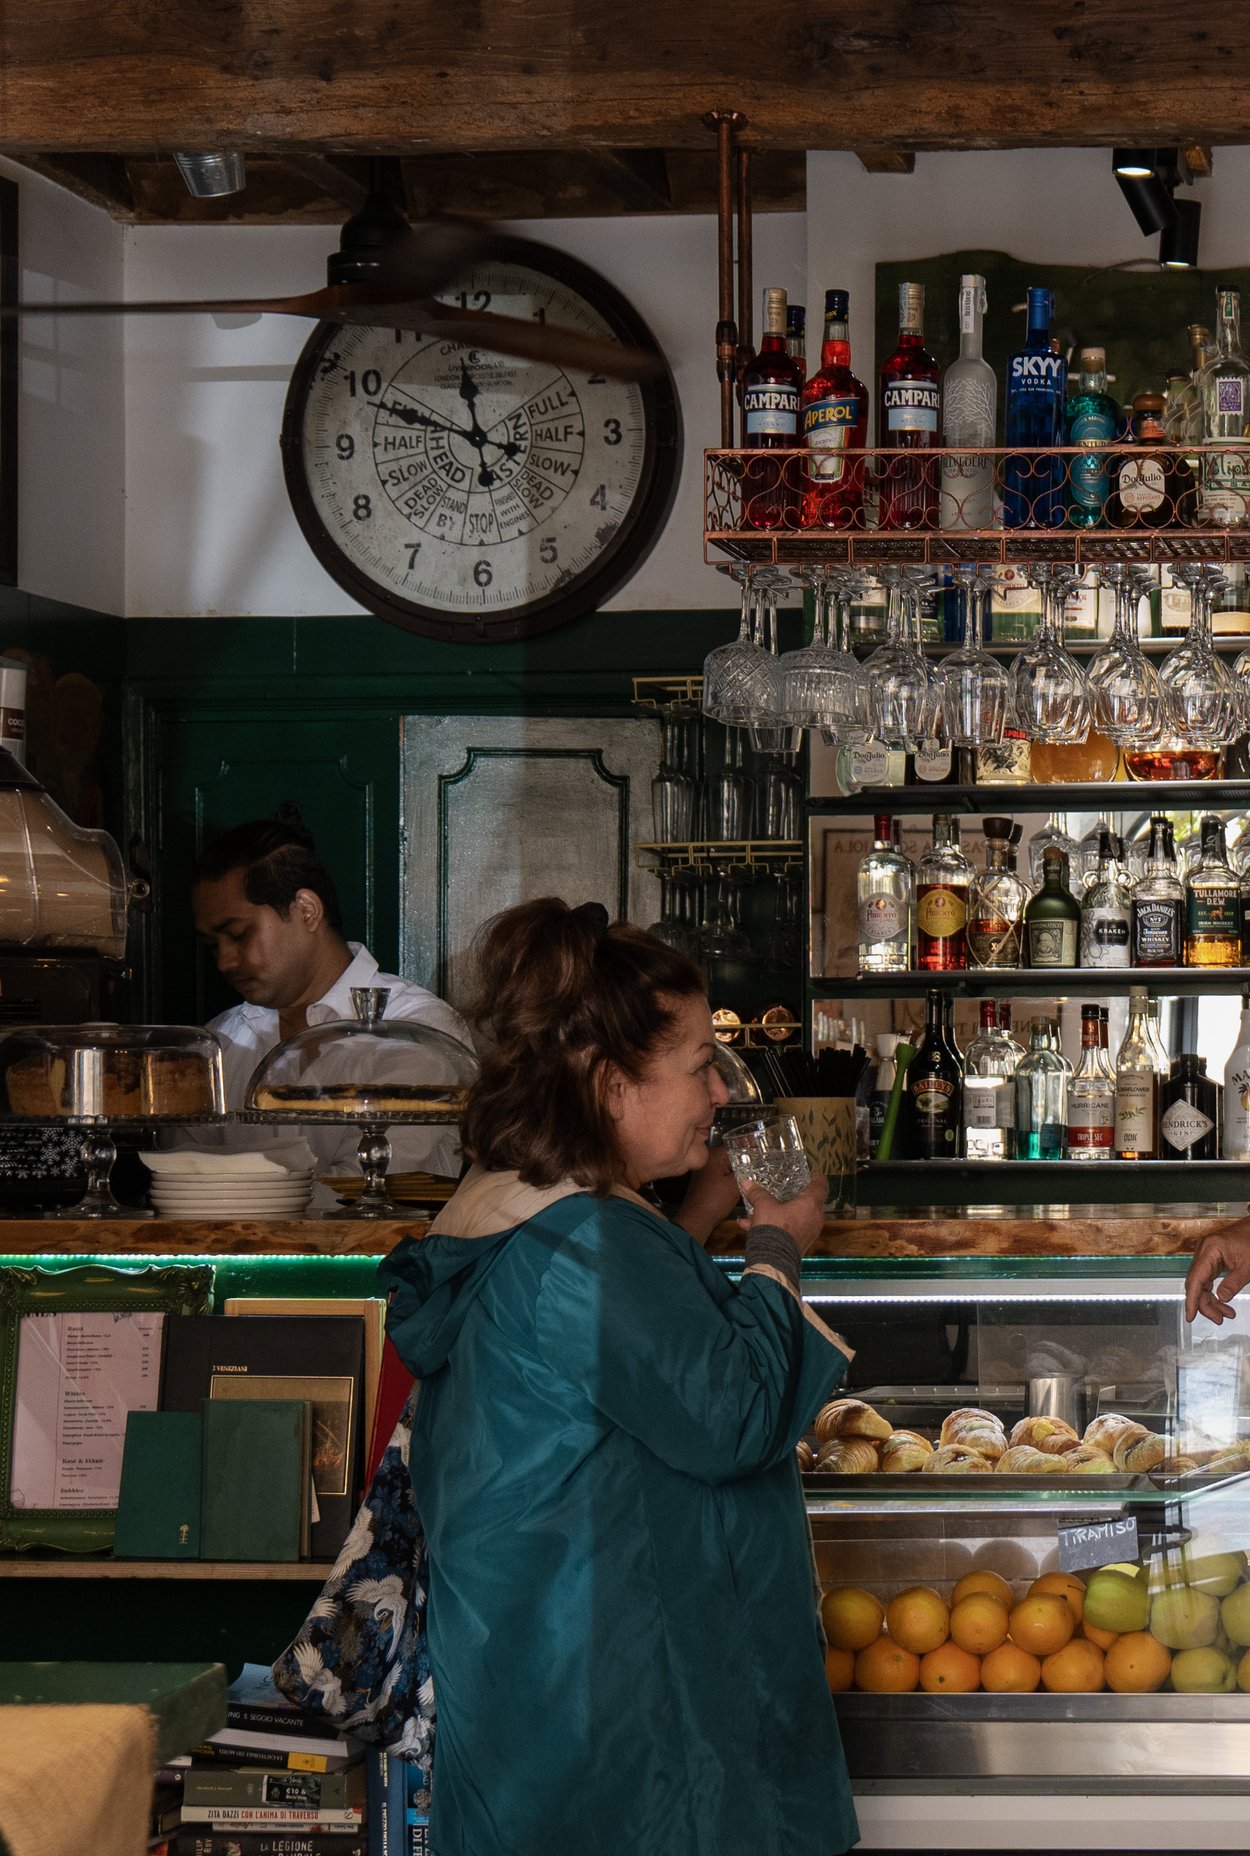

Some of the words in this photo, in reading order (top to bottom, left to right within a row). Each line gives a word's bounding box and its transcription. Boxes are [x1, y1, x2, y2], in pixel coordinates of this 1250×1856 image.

[1012, 356, 1061, 378] SKYY
[346, 369, 382, 397] 10
[529, 390, 568, 419] FULL
[744, 392, 800, 411] CAMPARI
[884, 390, 940, 408] CAMPARI
[805, 406, 853, 430] APEROL
[534, 424, 574, 442] HALF
[602, 418, 622, 446] 3
[336, 435, 356, 461] 9
[384, 436, 422, 452] HALF
[388, 459, 428, 486] SLOW
[529, 453, 572, 476] SLOW
[404, 476, 438, 510] DEAD
[513, 476, 544, 510] SLOW
[520, 469, 554, 500] DEAD
[352, 494, 372, 522] 8
[413, 486, 444, 519] SLOW
[440, 496, 467, 514] STAND
[590, 484, 608, 511] 4
[468, 513, 494, 534] STOP
[500, 511, 530, 530] ENGINES
[404, 542, 422, 570] 7
[539, 537, 558, 564] 5
[473, 560, 493, 588] 6
[1194, 890, 1237, 898] TULLAMORE
[1137, 904, 1152, 917] JACK
[1152, 903, 1176, 917] DANIEL'S
[913, 1079, 950, 1092] BAILEYS
[1078, 1133, 1093, 1141] TRIPLE
[1094, 1133, 1103, 1141] SEC
[250, 1713, 272, 1723] SEGGIO
[274, 1716, 304, 1726] VACANTE
[208, 1810, 220, 1818] ZITA
[222, 1810, 240, 1818] DAZZI
[272, 1841, 313, 1851] LEGIONE
[413, 1829, 423, 1842] DI
